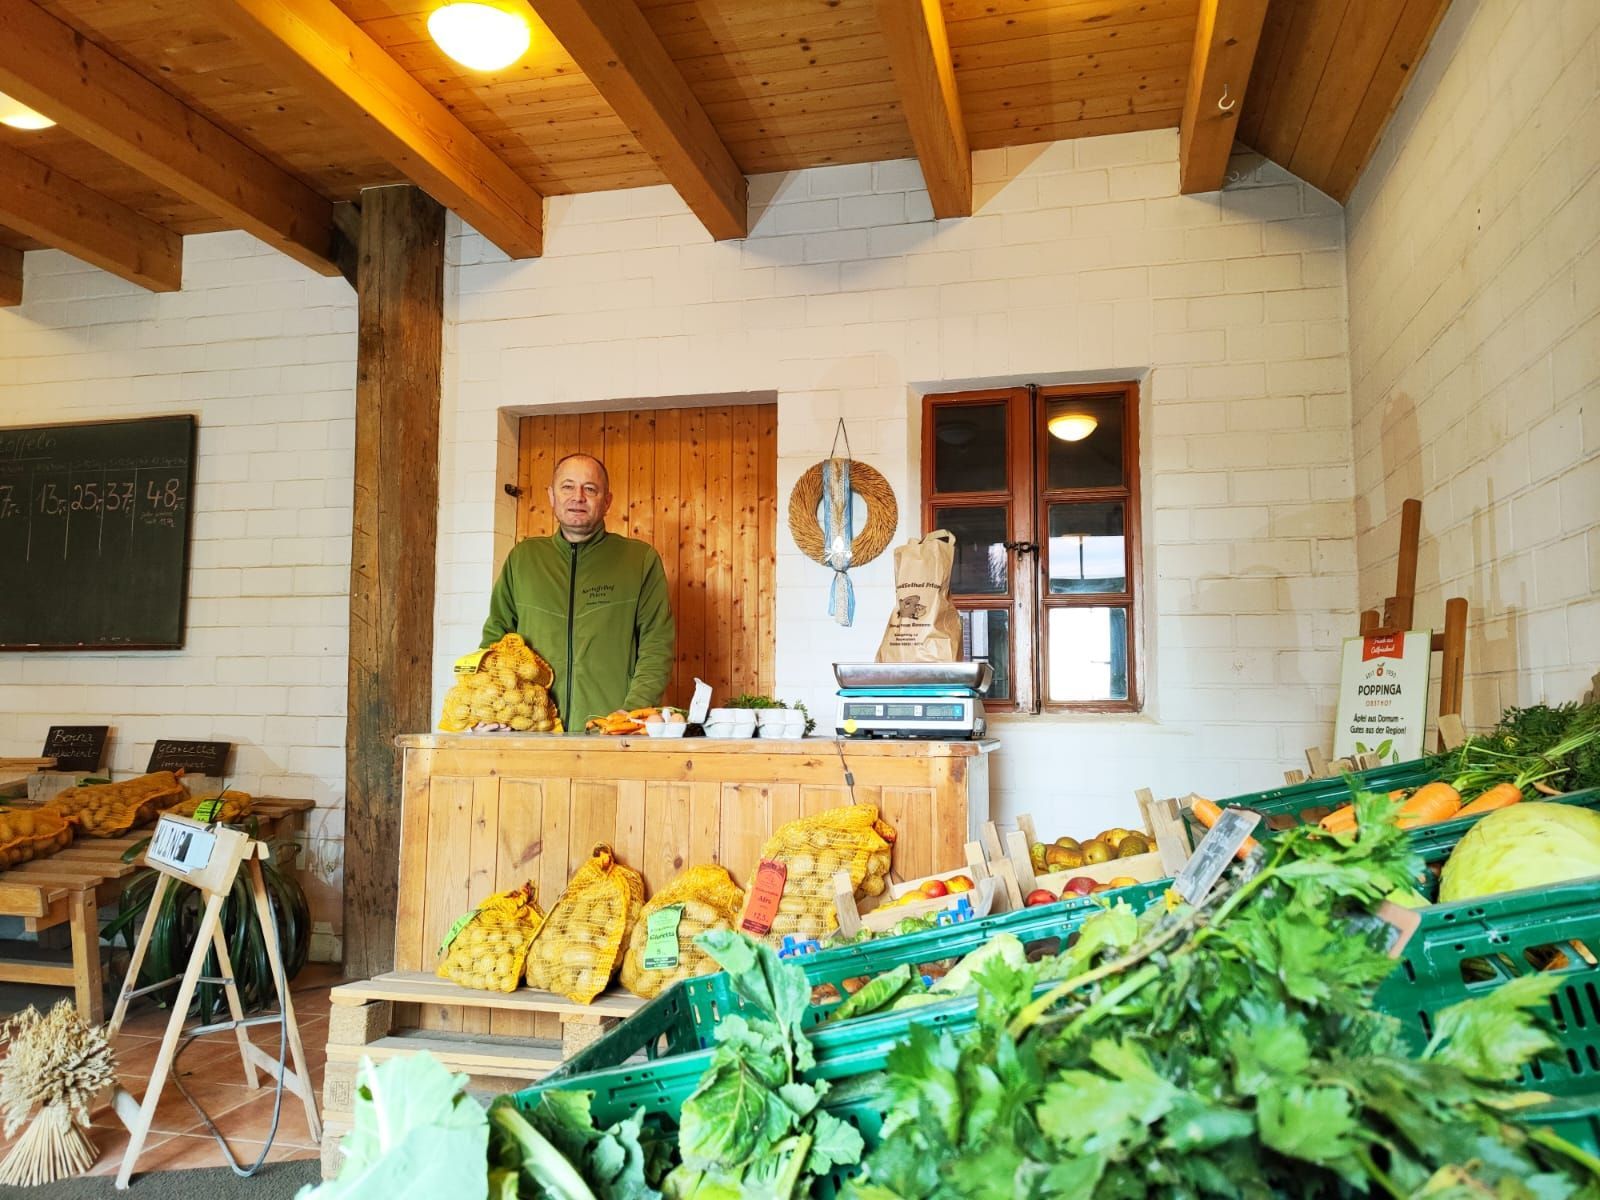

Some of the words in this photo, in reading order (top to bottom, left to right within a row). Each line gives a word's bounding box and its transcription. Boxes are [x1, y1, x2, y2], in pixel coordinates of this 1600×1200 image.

[1358, 684, 1402, 696] POPPINGA
[1378, 714, 1399, 722] Dornum
[1350, 725, 1364, 734] Gutes
[1375, 725, 1385, 734] der
[1385, 725, 1407, 736] Region!
